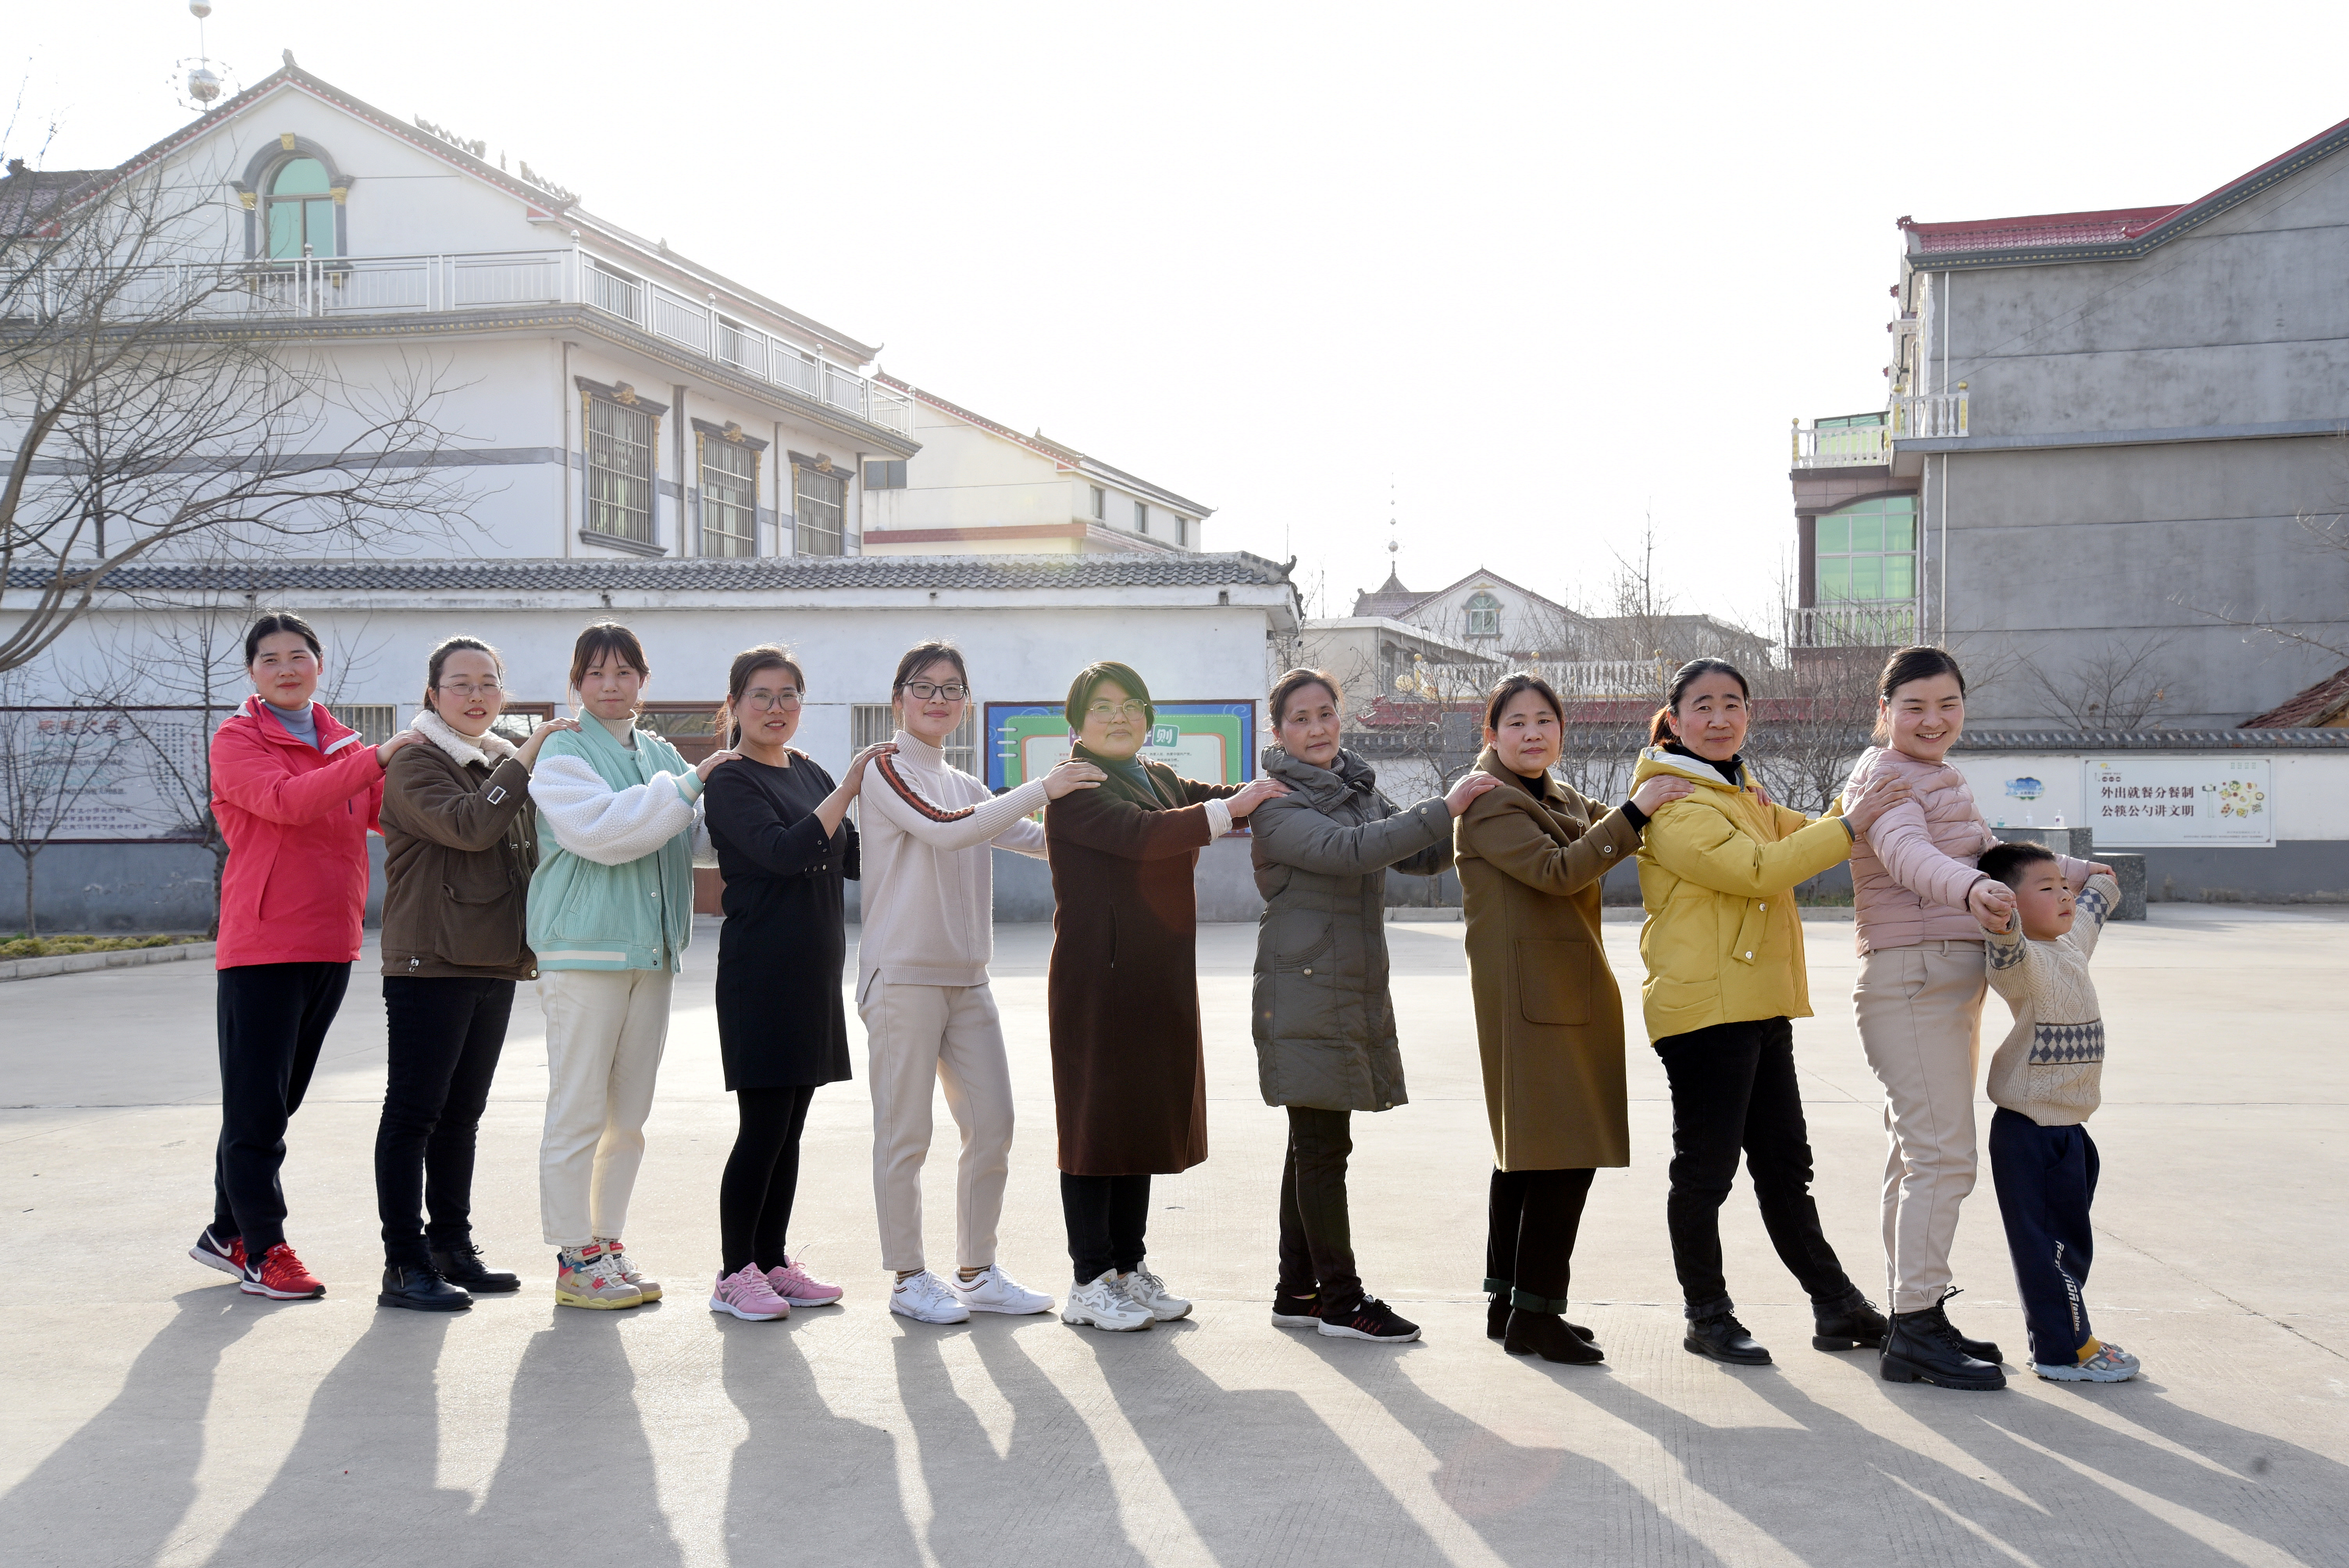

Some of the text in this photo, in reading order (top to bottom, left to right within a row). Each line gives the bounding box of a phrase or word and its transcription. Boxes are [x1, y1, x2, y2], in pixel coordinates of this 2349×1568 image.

[2101, 786, 2194, 799] 外出就餐分餐制
[2101, 805, 2194, 817] 公筷公勺讲文明
[2072, 1303, 2081, 1331] fashion
